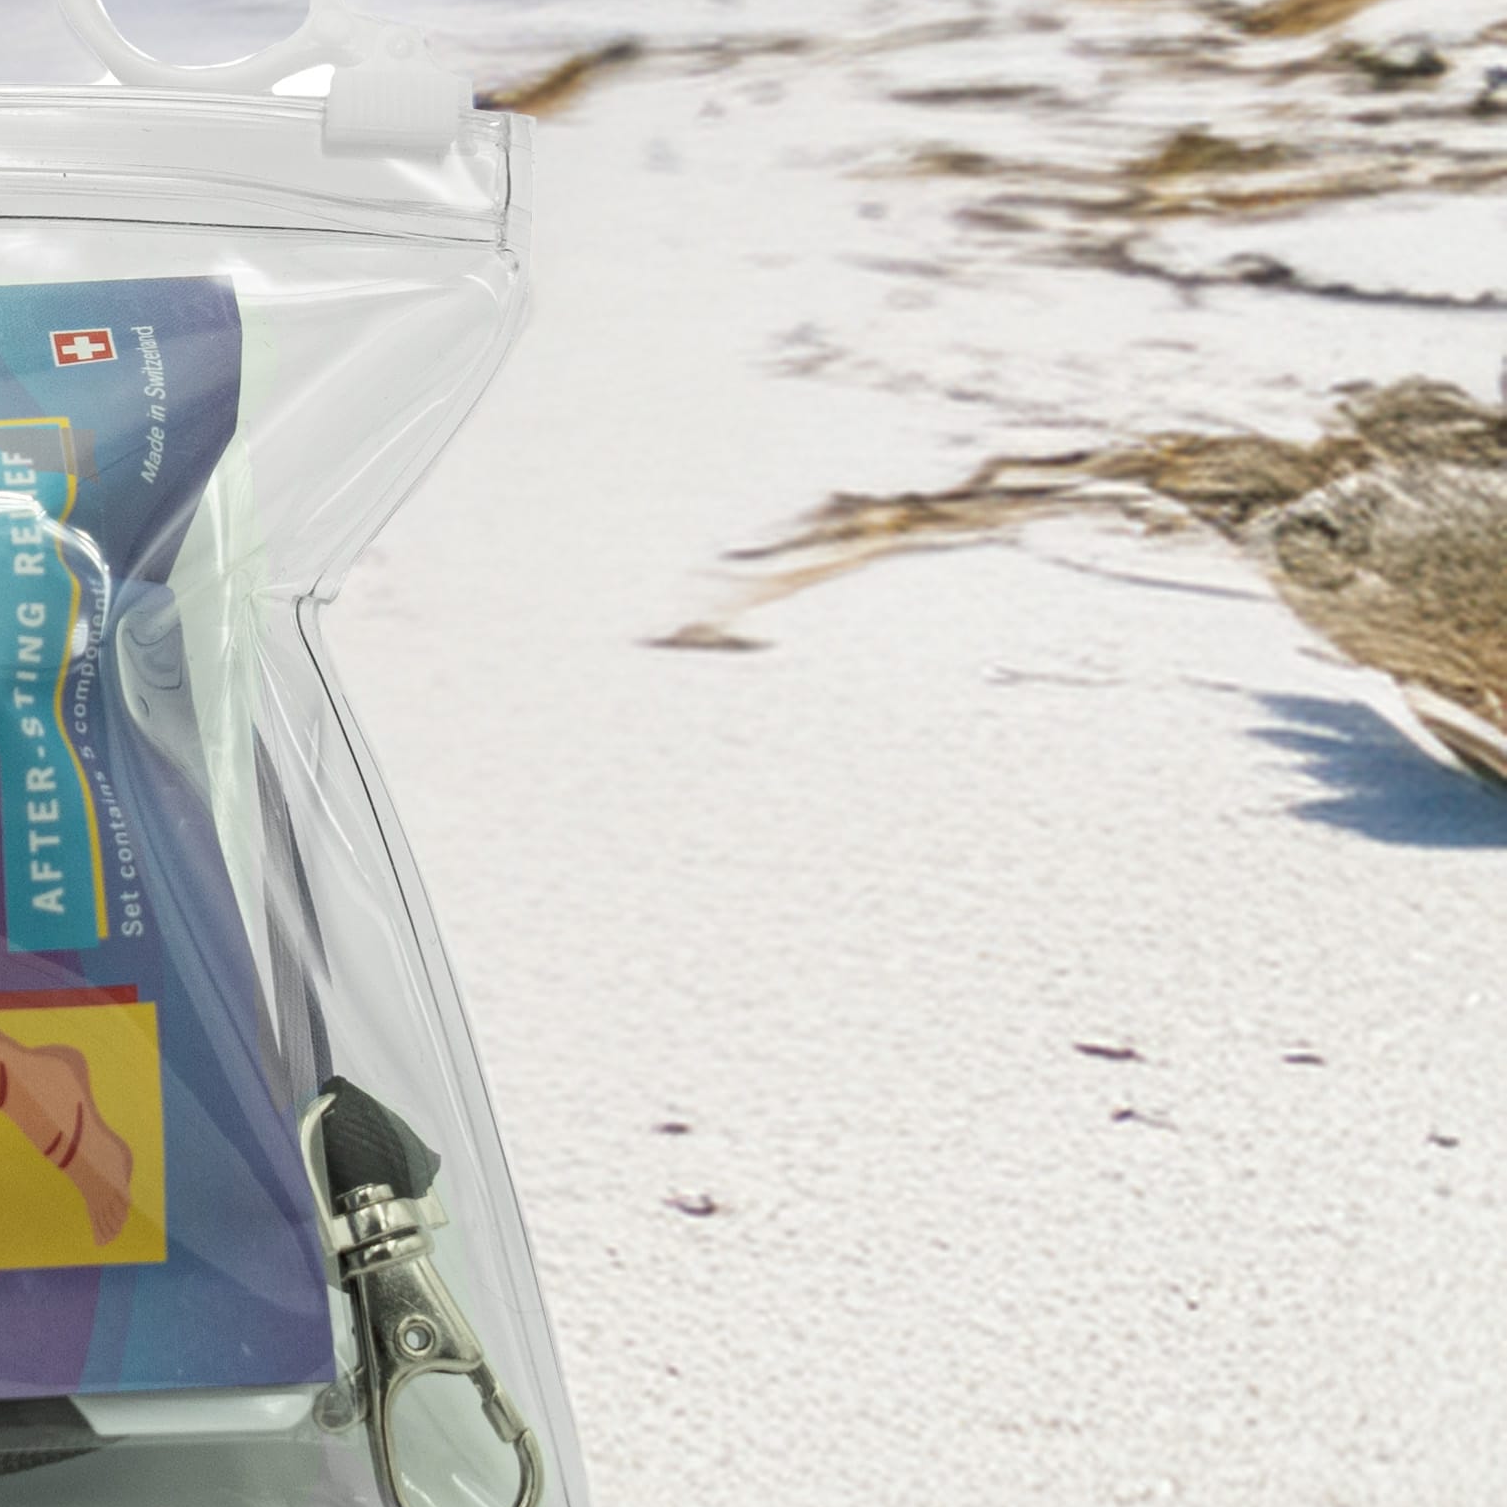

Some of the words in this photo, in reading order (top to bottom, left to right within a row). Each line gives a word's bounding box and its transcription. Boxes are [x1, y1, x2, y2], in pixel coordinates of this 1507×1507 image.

[131, 325, 166, 401] Switzerland
[146, 403, 167, 423] in
[140, 426, 164, 485] Made
[8, 600, 66, 914] AFTER-STING
[96, 768, 136, 879] contains
[121, 887, 144, 937] Set
